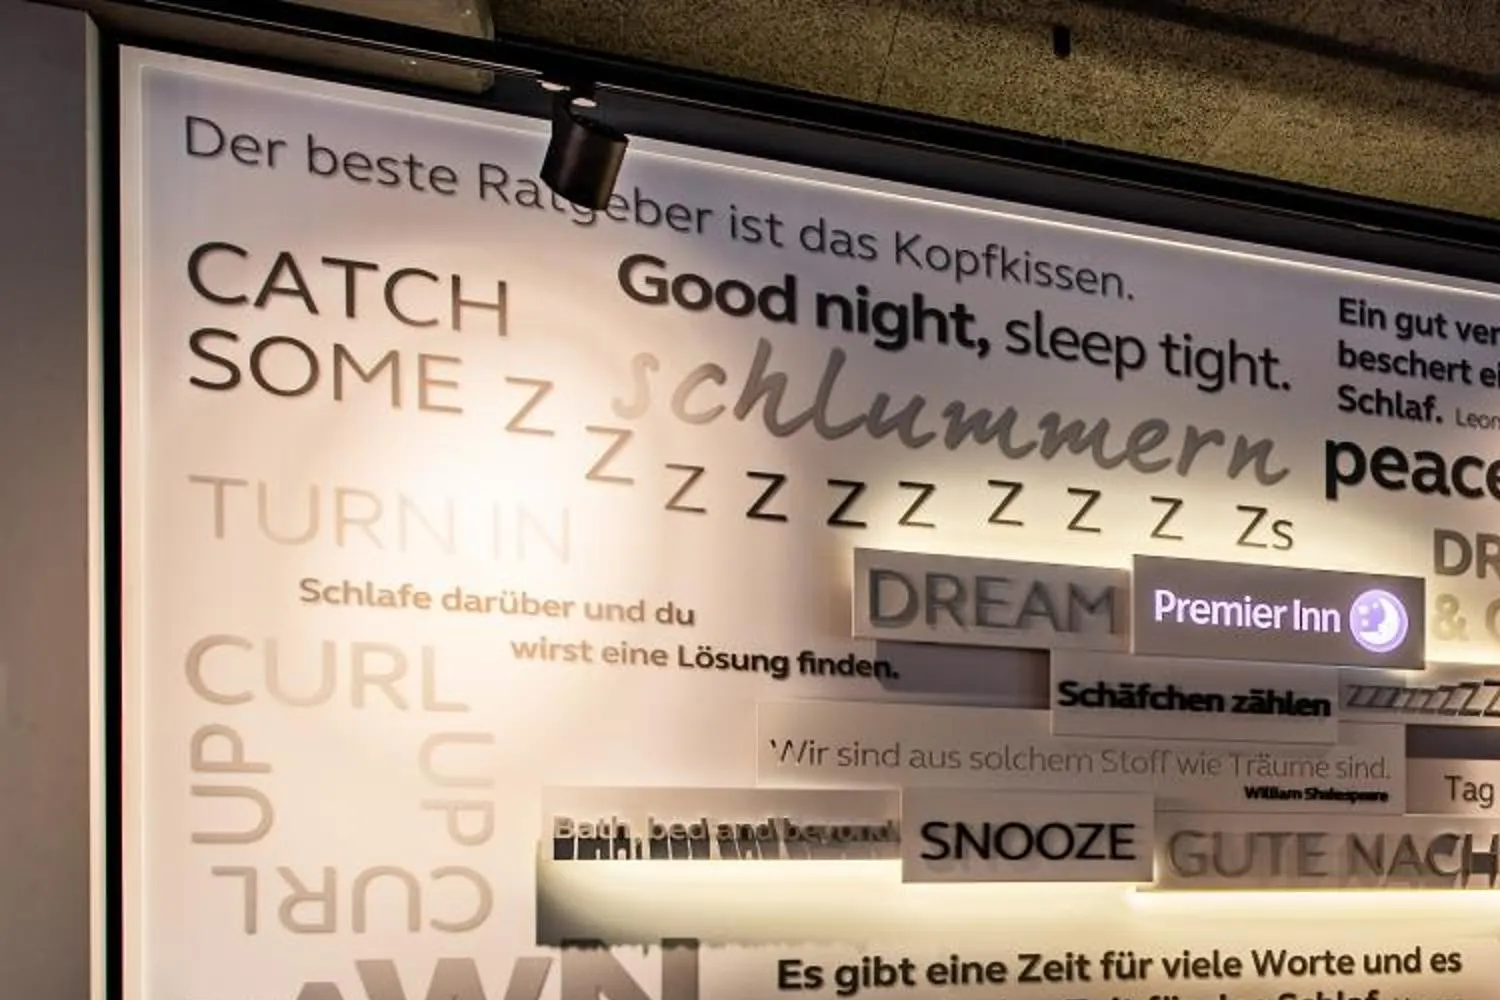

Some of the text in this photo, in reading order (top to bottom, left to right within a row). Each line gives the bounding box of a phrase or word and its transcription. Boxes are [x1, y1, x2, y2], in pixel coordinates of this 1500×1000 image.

[185, 116, 287, 168] Der
[307, 132, 458, 195] beste
[729, 204, 784, 248] ist
[800, 217, 878, 262] das
[894, 232, 1136, 302] Kopfkissen.
[186, 241, 508, 336] CATCH
[617, 253, 1292, 393] Good night, sleep tight.
[1338, 297, 1387, 330] Ein
[1394, 312, 1448, 341] gut
[188, 327, 463, 414] SOME
[504, 376, 555, 436] Z
[1337, 340, 1474, 386] beschert
[613, 336, 1290, 487] schlummern
[1337, 385, 1444, 424] Schlaf.
[187, 473, 458, 556] TURN
[300, 576, 696, 628] Schlafe darüber und du
[868, 567, 1120, 636] DREAM
[1154, 588, 1341, 634] Premier Inn
[1432, 594, 1469, 644] &
[184, 633, 471, 713] CURL
[511, 635, 900, 681] wirst eine Lösung finden.
[1058, 680, 1332, 718] Schäfchen zählen
[190, 724, 275, 845] UP
[770, 738, 1391, 781] Wir sind aus solchem Stoff wie Träume sind.
[417, 731, 496, 846] UP
[1444, 774, 1494, 809] Tag
[648, 816, 709, 842] bed
[716, 817, 778, 843] and
[919, 820, 1137, 863] SNOOZE
[1169, 830, 1330, 878] GUTE
[211, 865, 493, 935] CURL
[777, 946, 1463, 997] Es gibt eine Zeit für viele Worte und es
